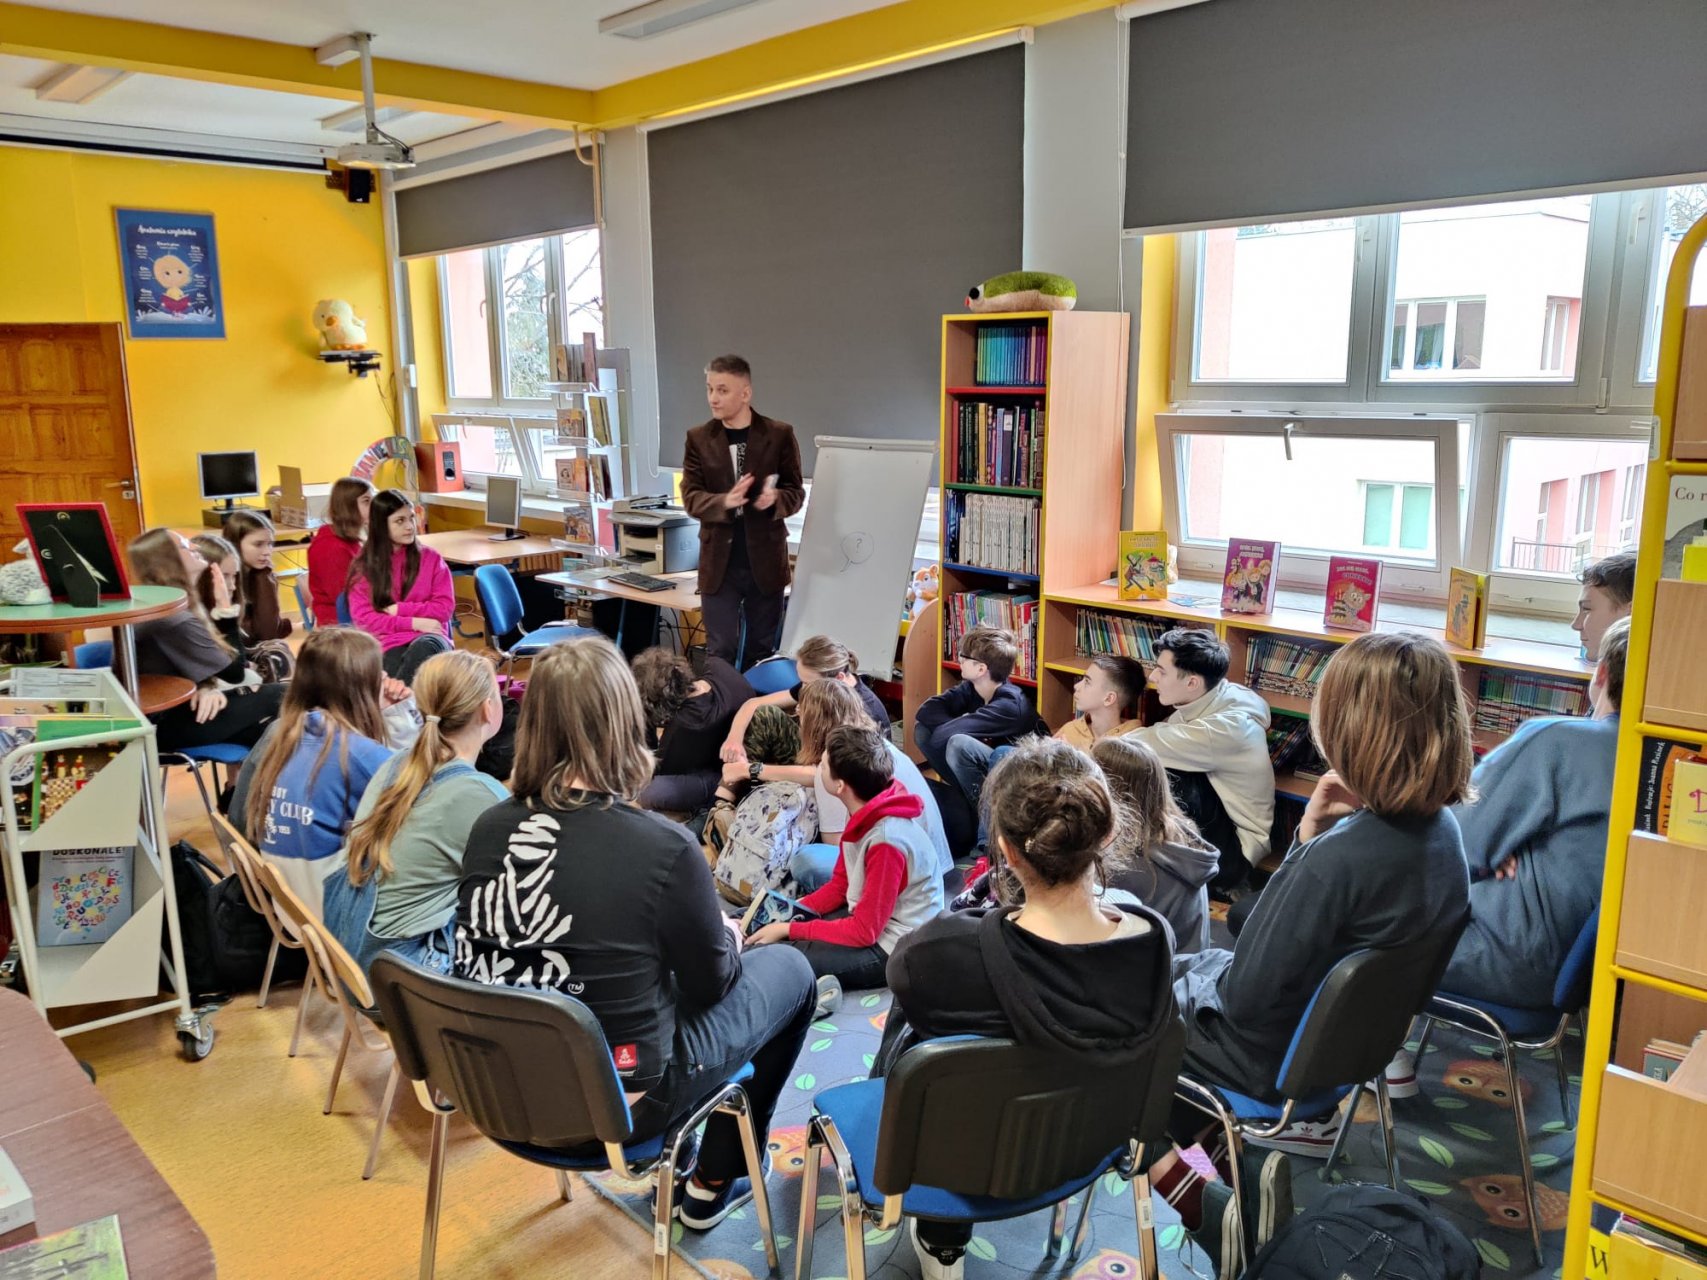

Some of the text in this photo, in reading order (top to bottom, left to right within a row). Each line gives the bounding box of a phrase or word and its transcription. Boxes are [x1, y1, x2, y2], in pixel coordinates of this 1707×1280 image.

[1675, 487, 1695, 501] Co
[280, 801, 314, 826] CLUB
[455, 925, 571, 992] DAKAR
